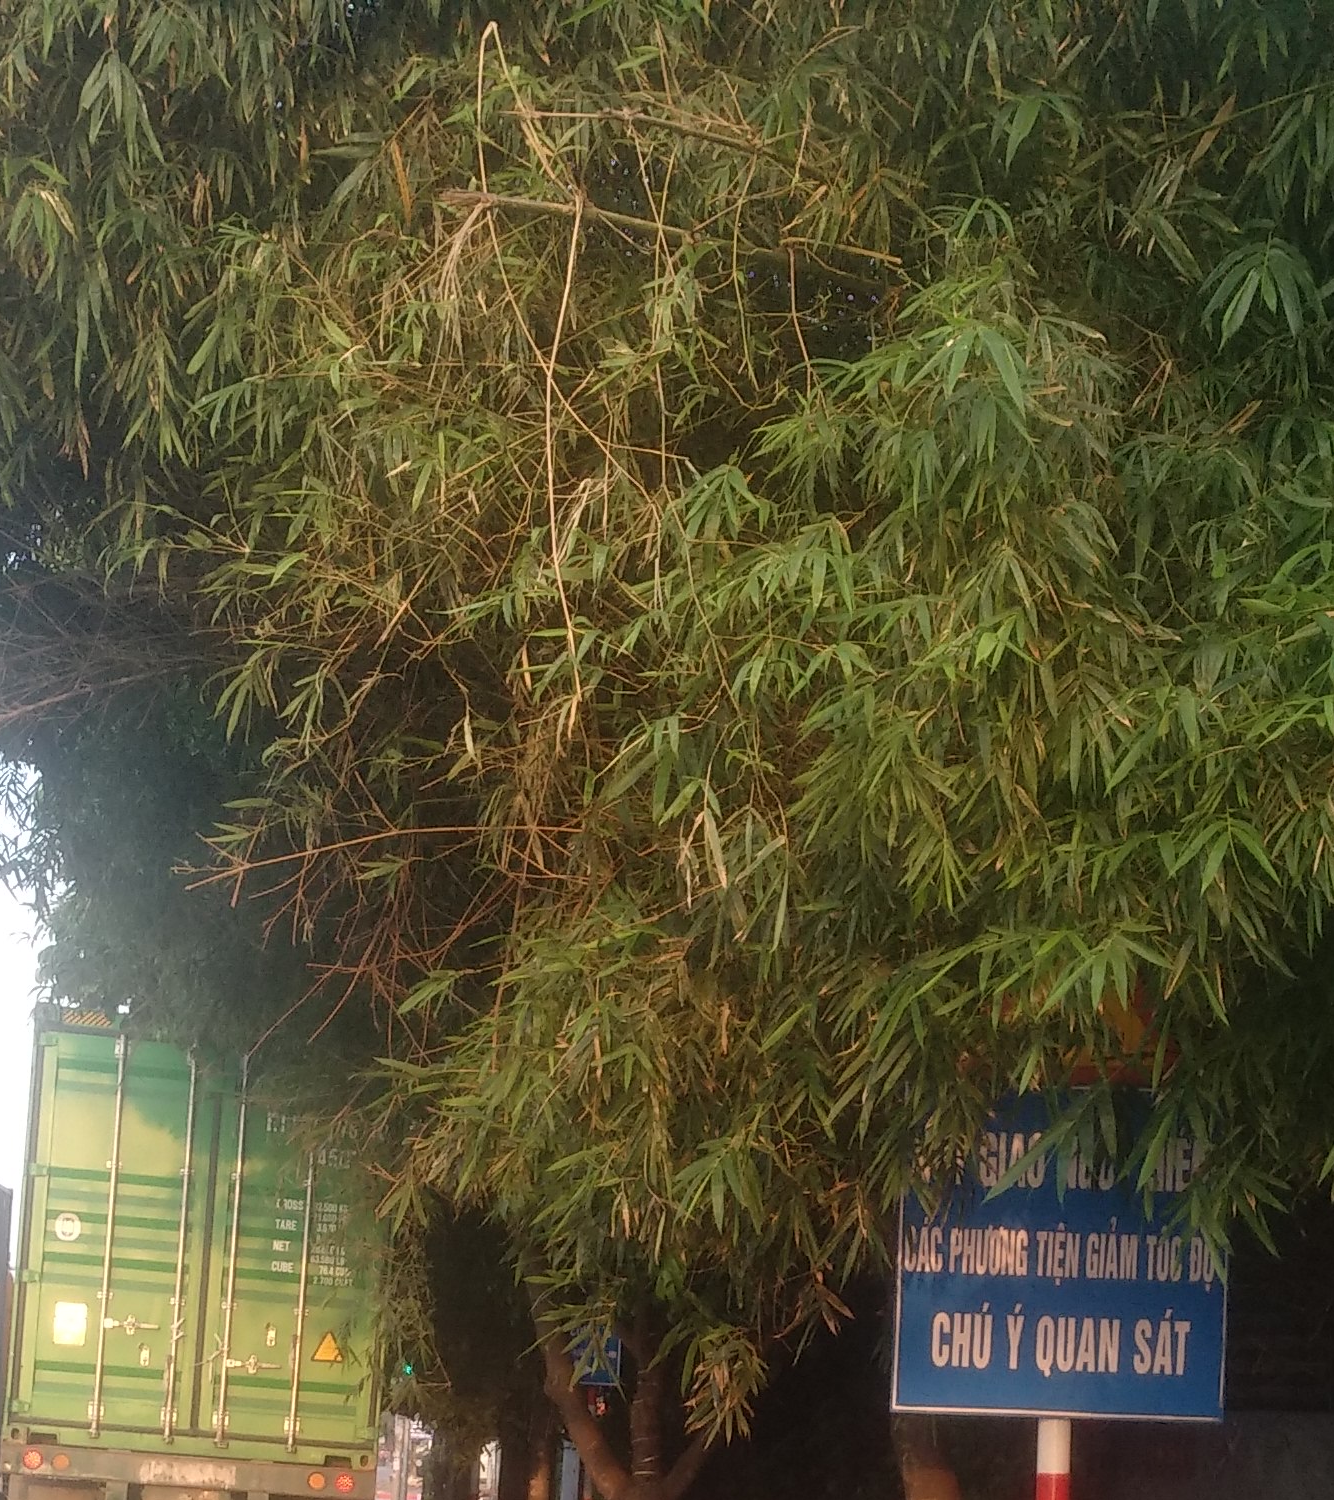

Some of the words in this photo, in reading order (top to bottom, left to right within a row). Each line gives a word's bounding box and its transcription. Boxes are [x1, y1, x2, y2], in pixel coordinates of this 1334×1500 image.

[979, 1131, 1046, 1188] GIAO
[275, 1218, 298, 1231] TARE
[272, 1239, 291, 1251] NET
[903, 1217, 944, 1273] CÁC
[948, 1225, 1029, 1277] PHƯƠNG
[1036, 1222, 1081, 1285] TIỆN
[1085, 1216, 1139, 1281] GIẢM
[271, 1261, 294, 1273] CUBE
[930, 1301, 993, 1369] CHÚ
[1006, 1303, 1026, 1370] Ý
[1035, 1315, 1121, 1378] QUAN
[1133, 1308, 1192, 1376] SÁT
